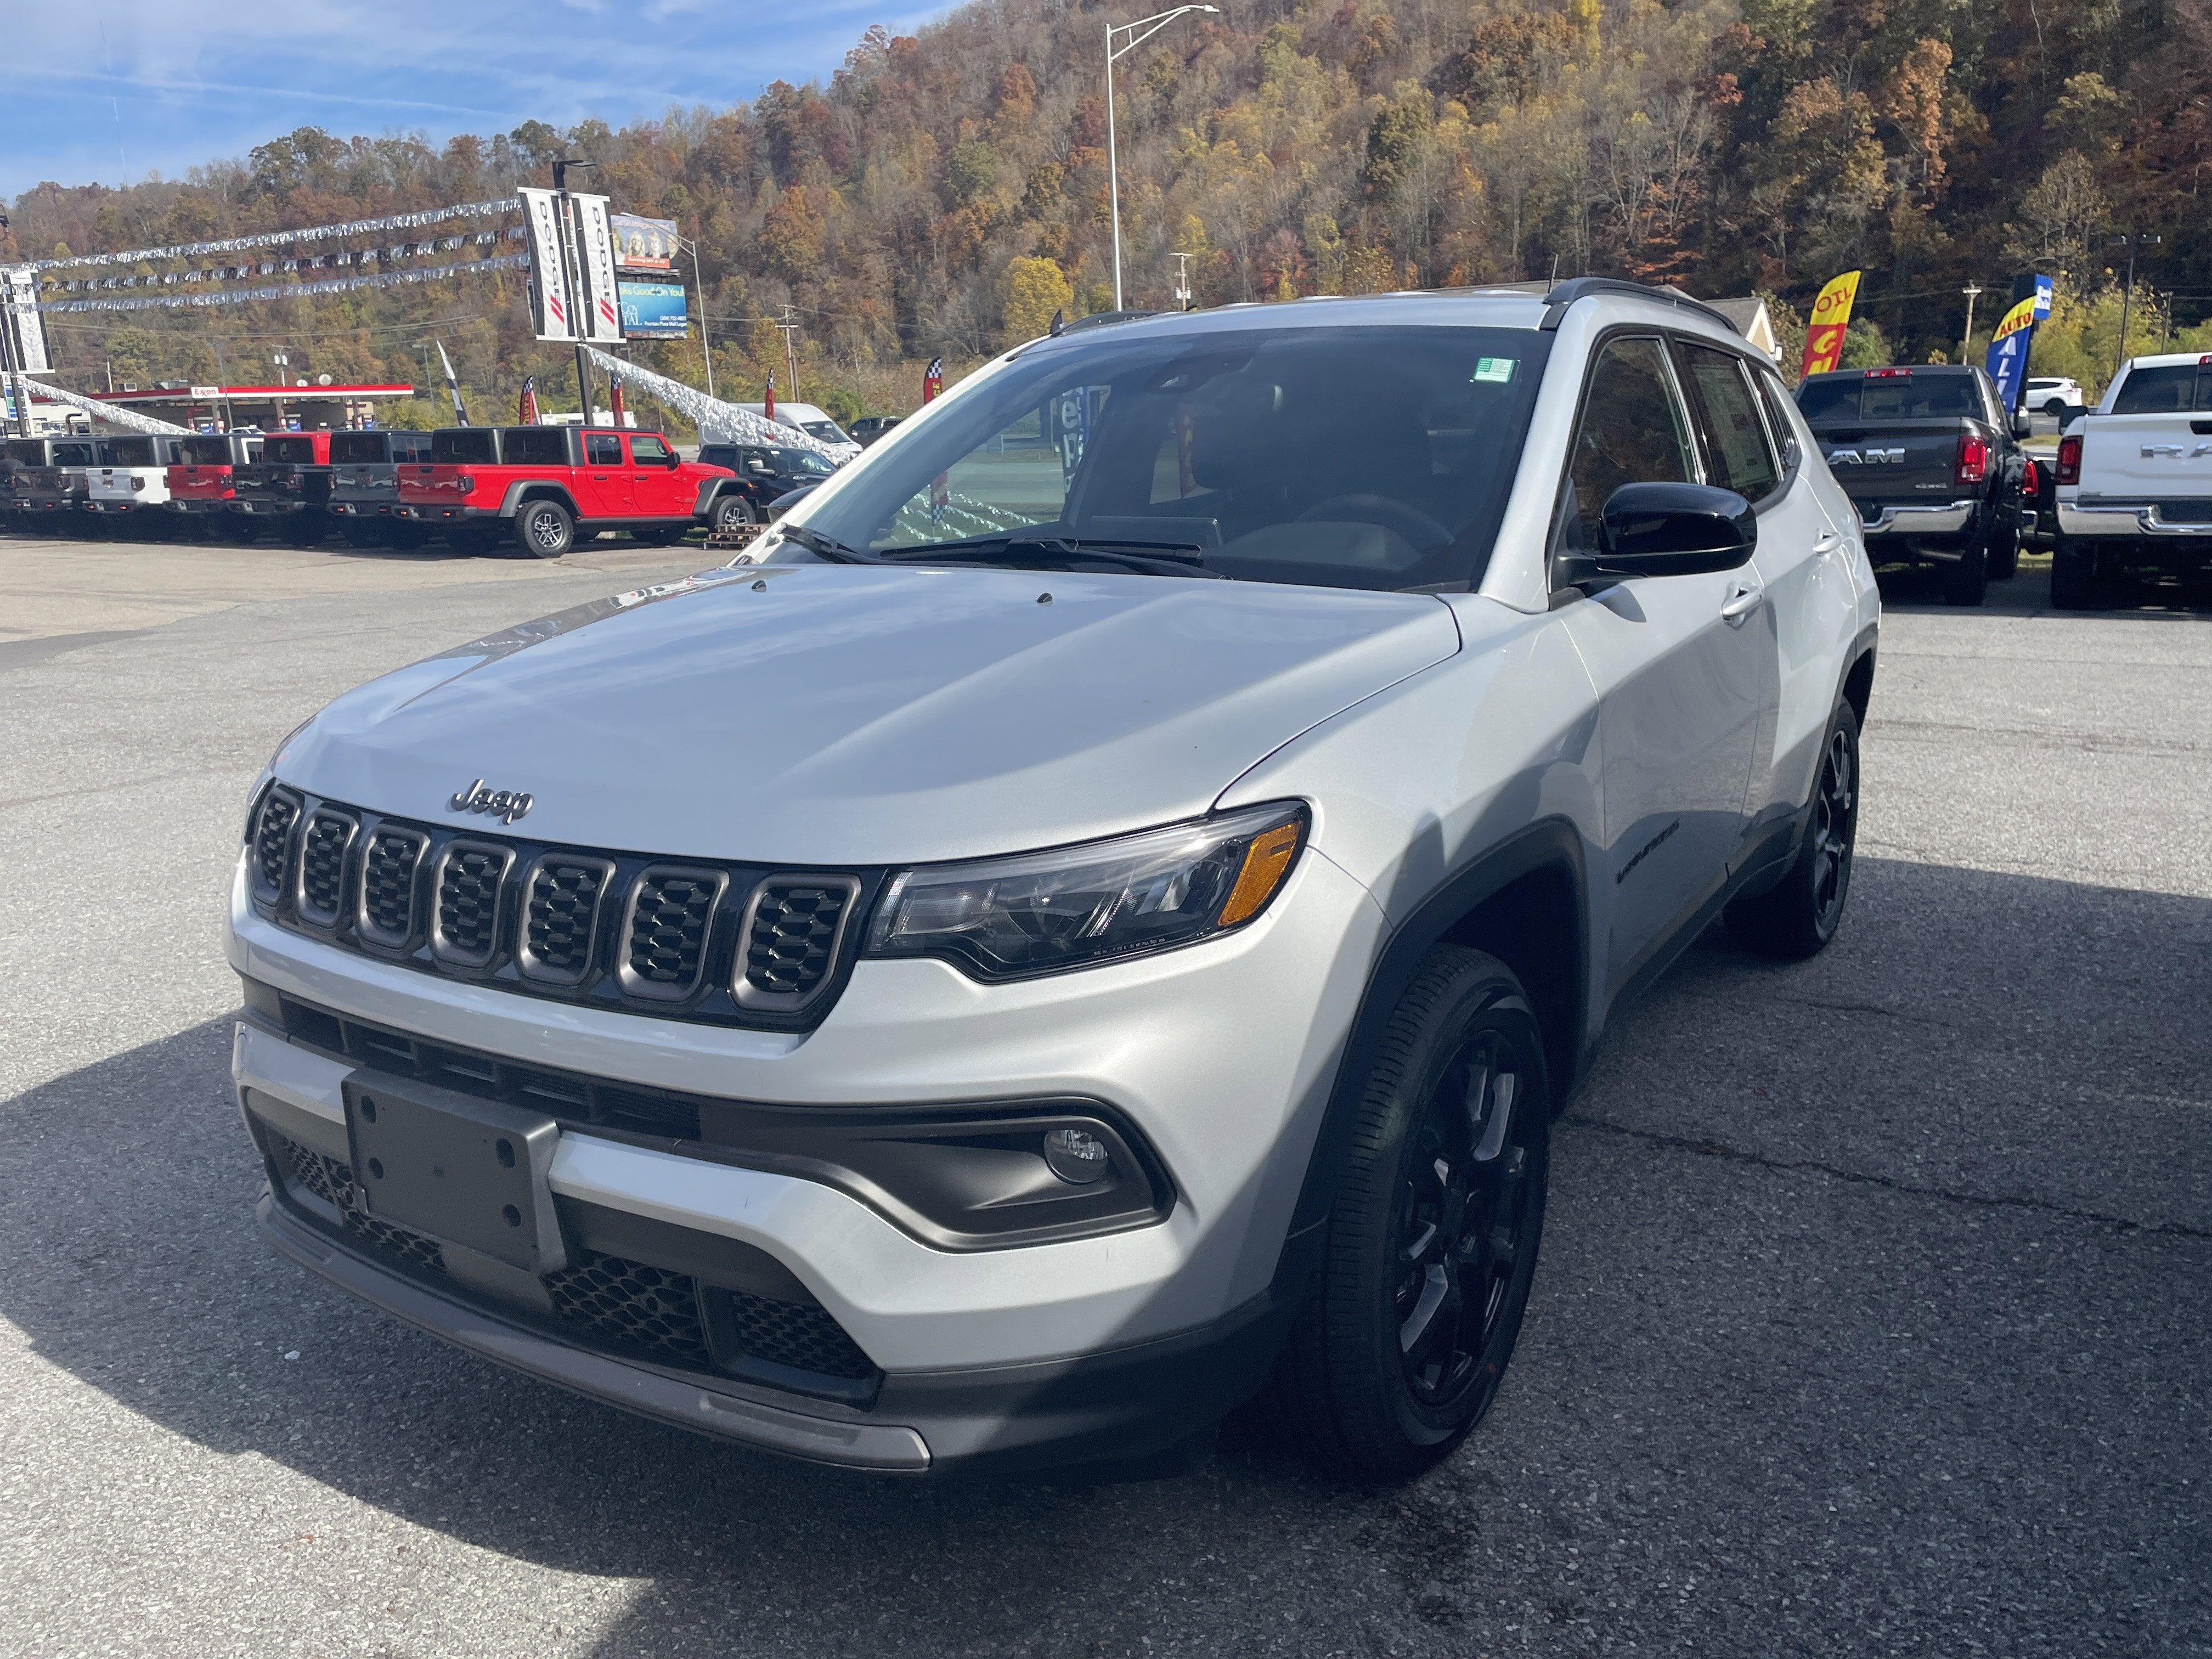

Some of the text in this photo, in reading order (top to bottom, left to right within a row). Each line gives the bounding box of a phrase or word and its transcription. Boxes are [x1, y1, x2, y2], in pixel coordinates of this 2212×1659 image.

[633, 286, 655, 296] Good
[1817, 287, 1852, 313] OIL
[2000, 312, 2032, 337] AUTO
[194, 388, 216, 397] Exxon
[1826, 448, 1905, 465] AM
[450, 778, 534, 825] Jeep
